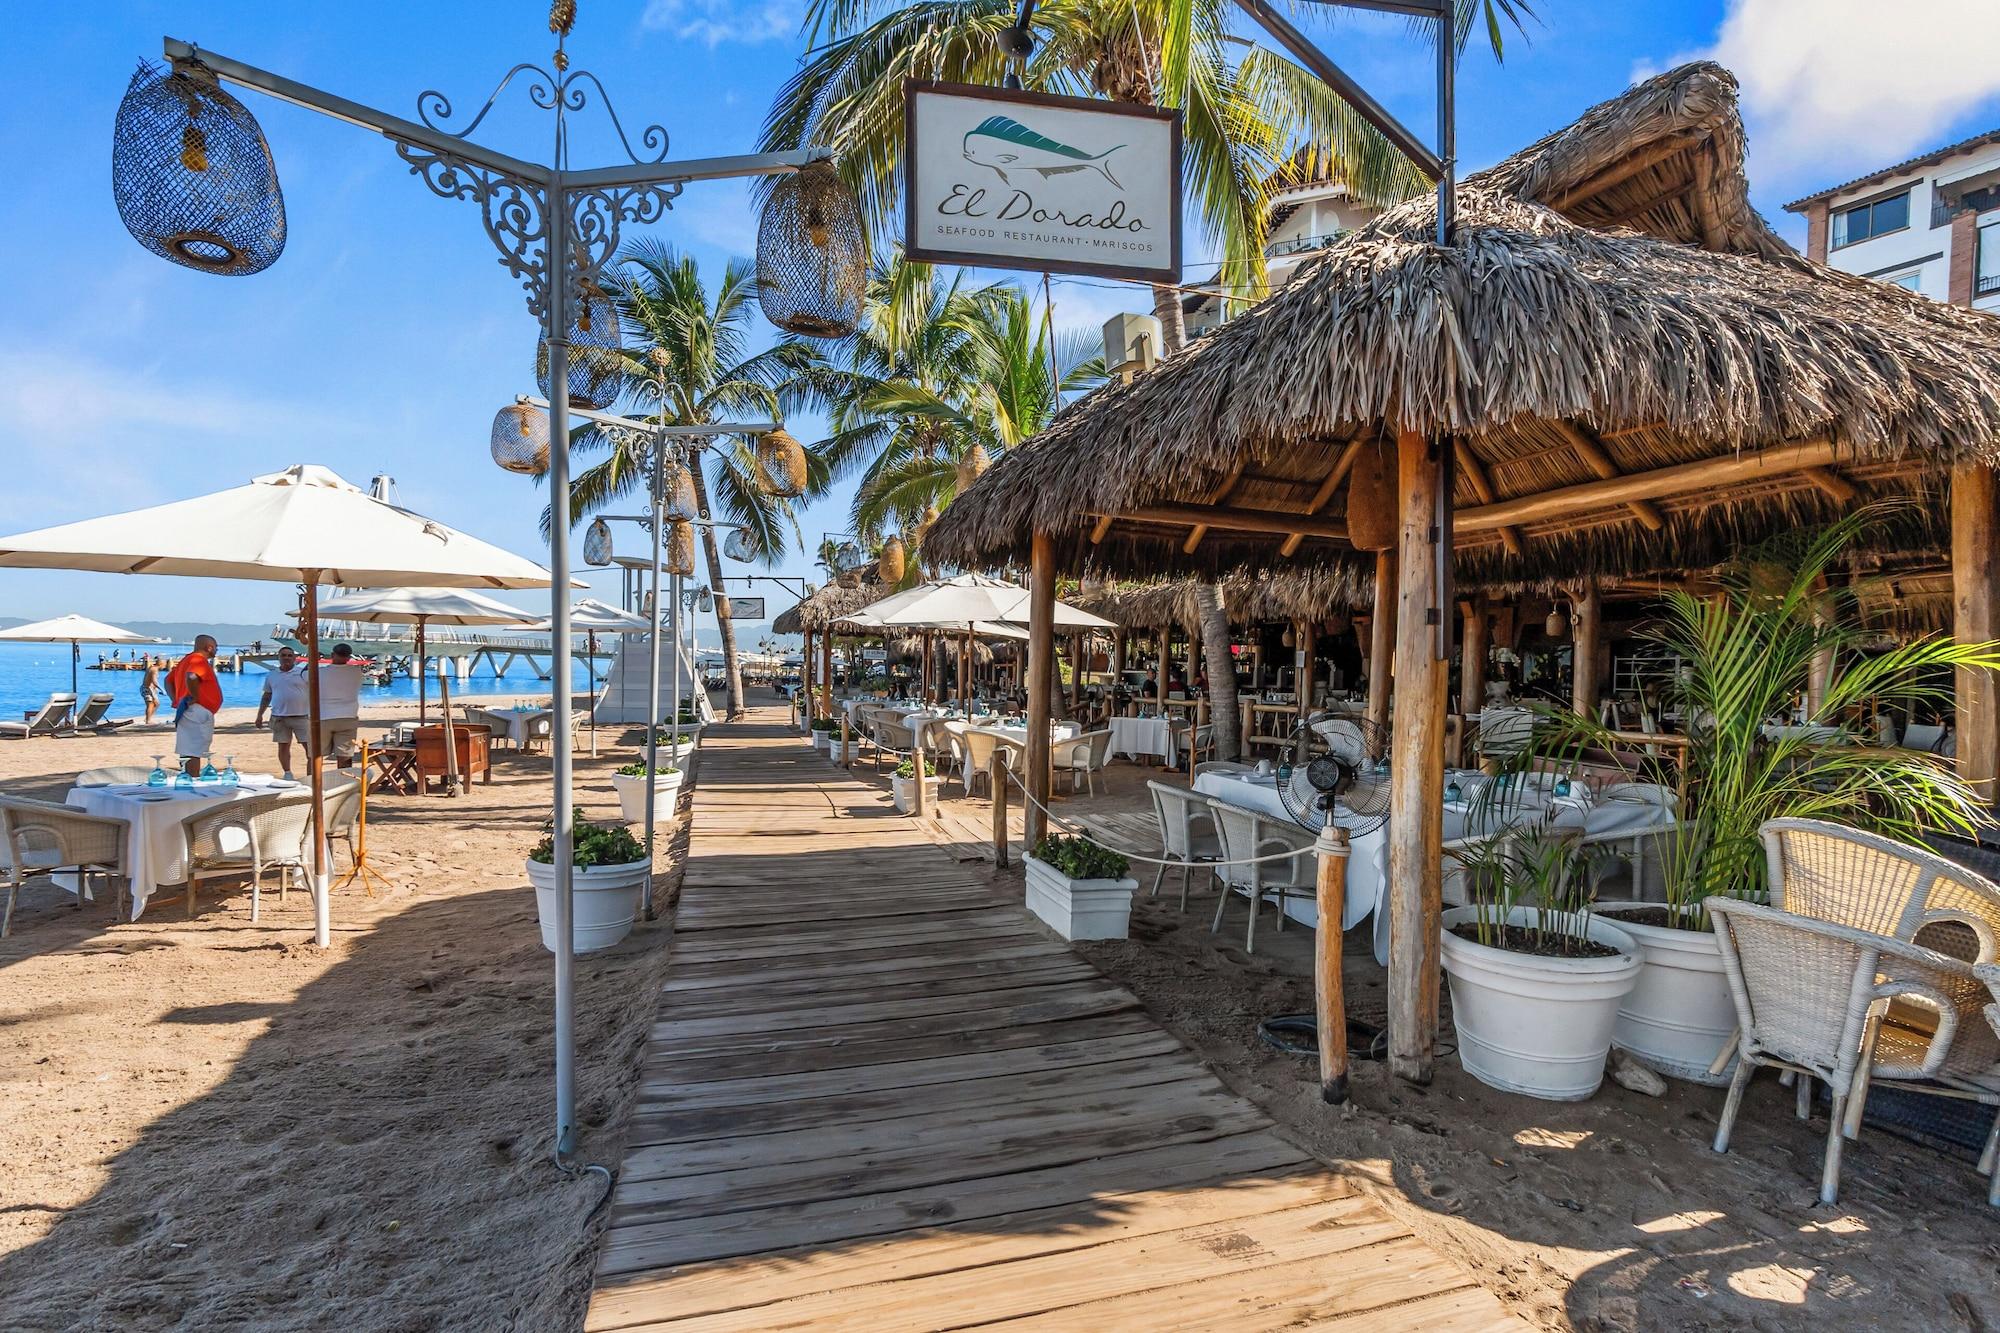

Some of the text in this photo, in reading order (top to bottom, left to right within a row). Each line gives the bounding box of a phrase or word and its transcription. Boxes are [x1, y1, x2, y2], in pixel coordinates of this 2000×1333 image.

[937, 184, 1152, 233] El Dorado
[937, 225, 1154, 252] SEAFOOD RESTAURANT MARISCOS
